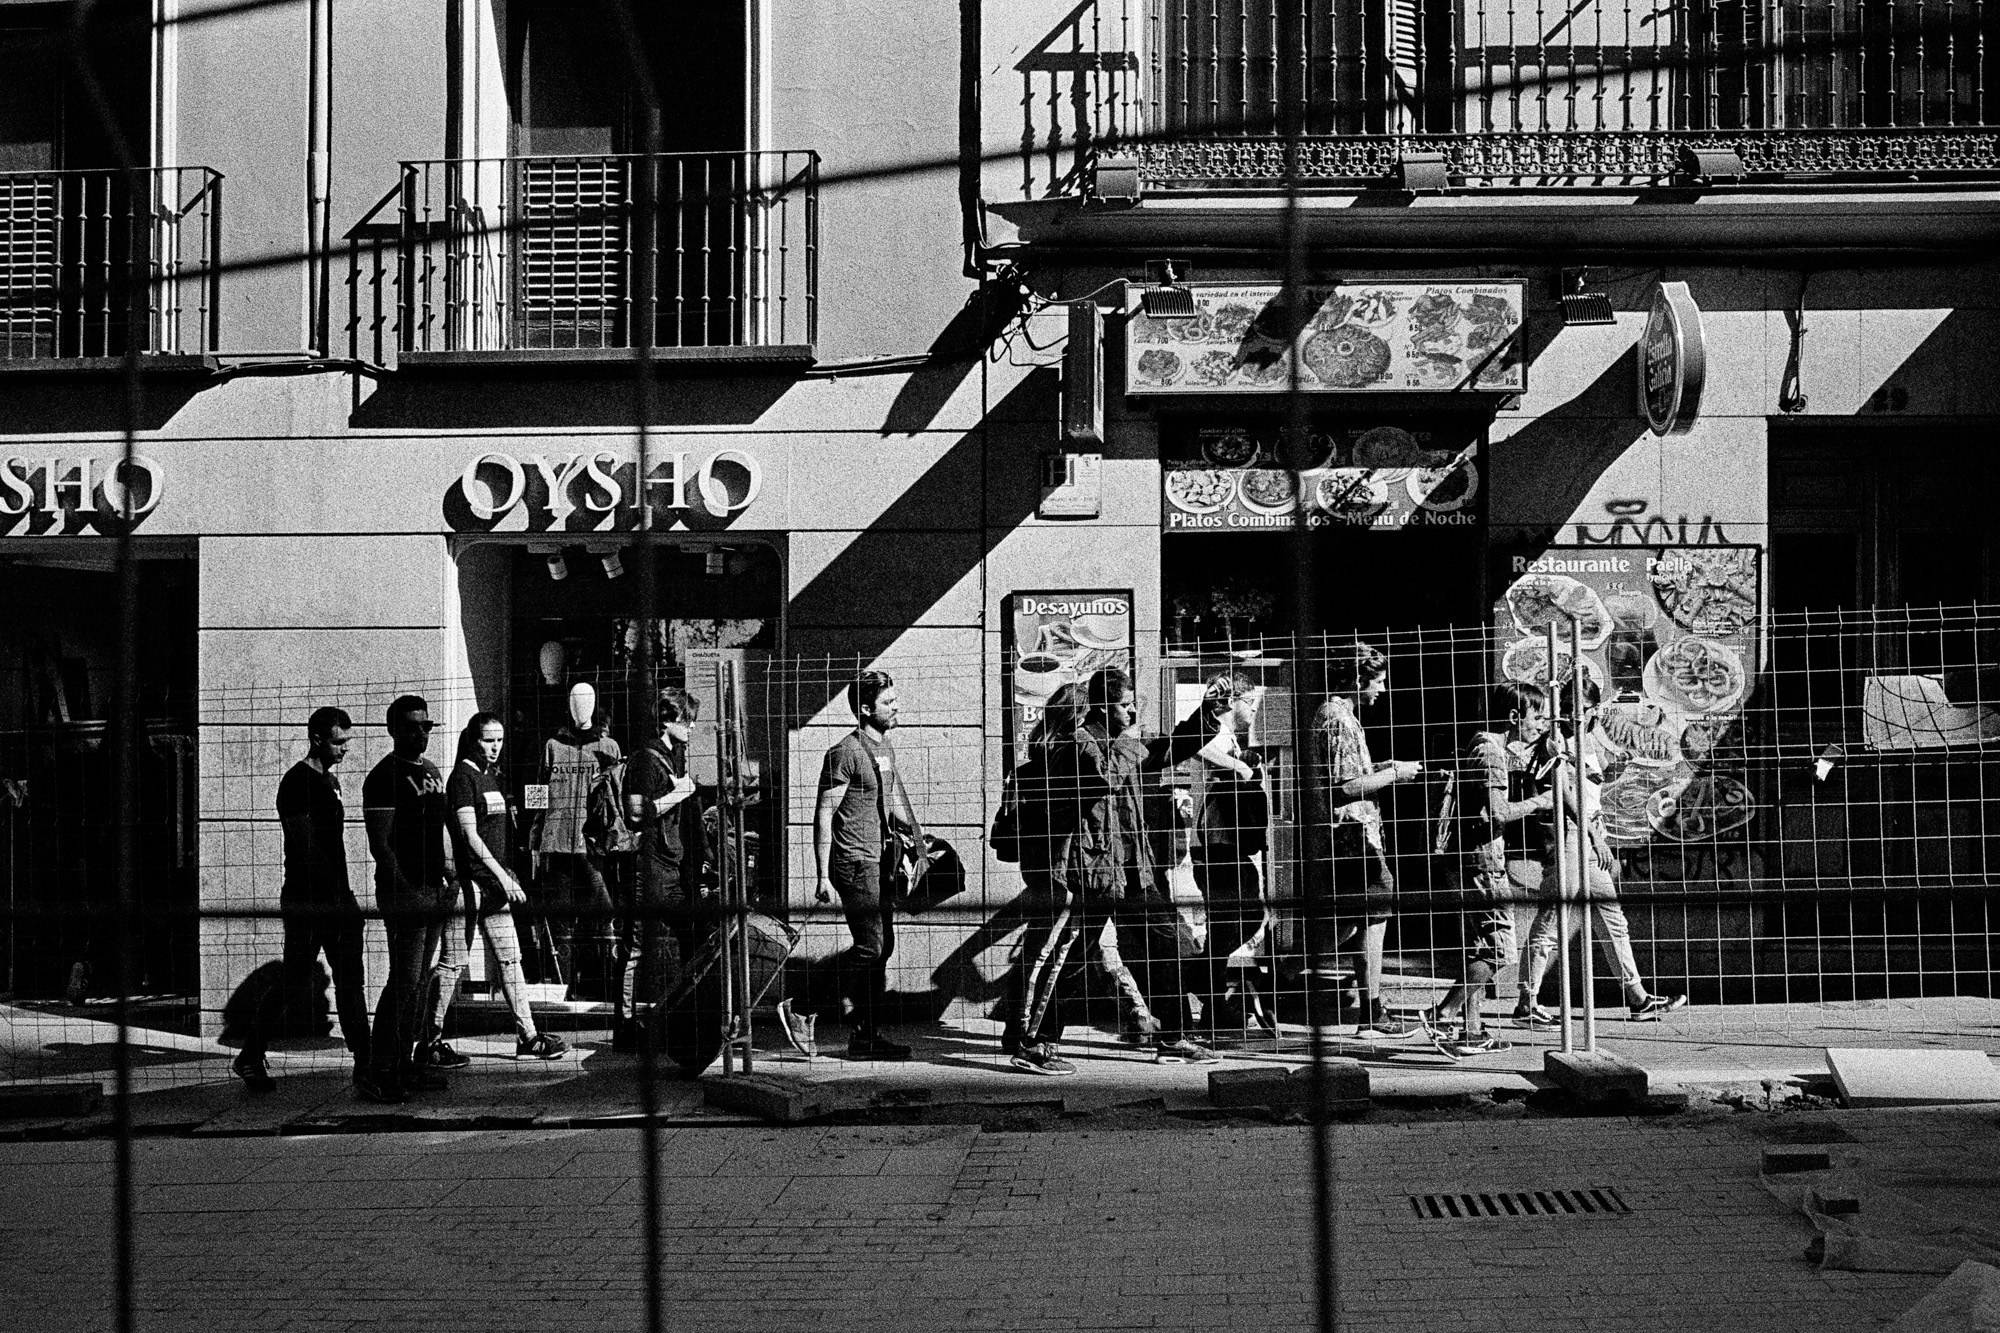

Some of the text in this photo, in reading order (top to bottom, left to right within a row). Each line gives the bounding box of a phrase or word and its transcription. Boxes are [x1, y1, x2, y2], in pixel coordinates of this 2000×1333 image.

[1196, 290, 1229, 298] variedad
[461, 450, 762, 512] OYSHO
[1170, 512, 1223, 527] Platos
[1346, 511, 1394, 526] Menú
[1400, 511, 1419, 526] de
[1425, 511, 1477, 526] Noche
[1512, 556, 1693, 573] Restaurante Paella
[1022, 597, 1129, 618] Desayunos
[545, 764, 600, 775] OLLECTI
